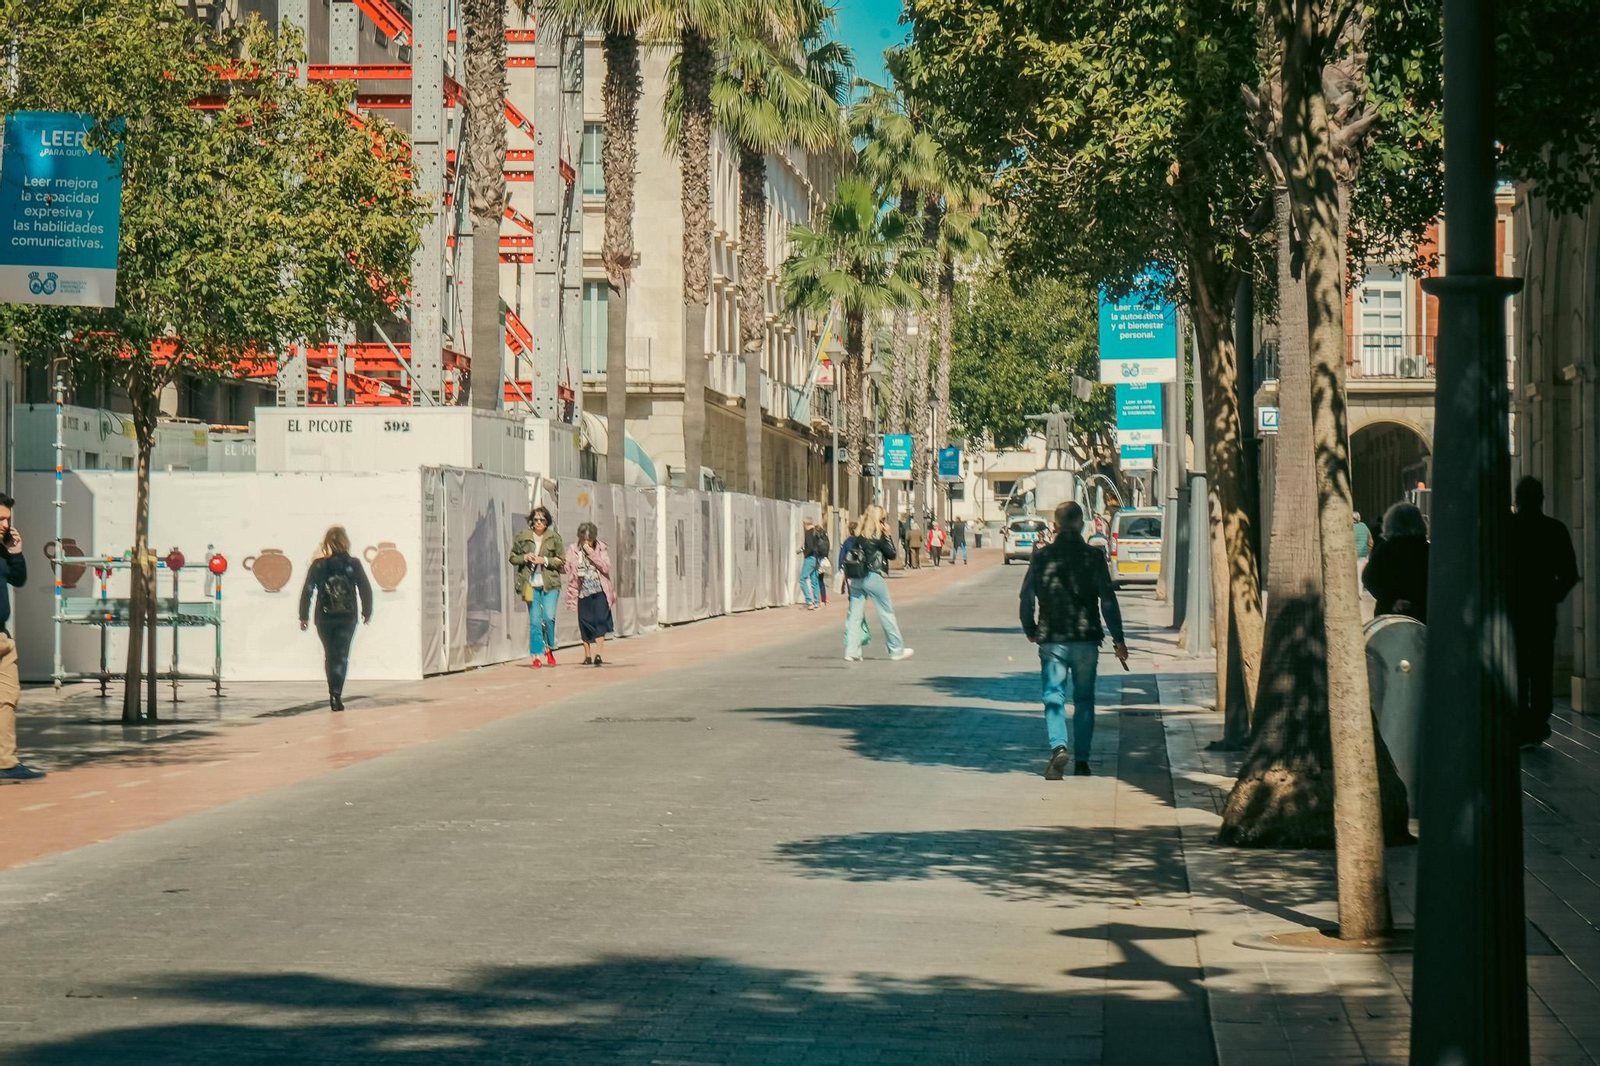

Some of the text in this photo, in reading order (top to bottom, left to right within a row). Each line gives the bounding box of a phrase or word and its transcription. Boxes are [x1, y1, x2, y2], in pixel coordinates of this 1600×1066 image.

[41, 129, 88, 147] LEER
[39, 148, 64, 157] ¿PARA
[24, 176, 98, 191] Leer mejora
[21, 190, 99, 204] la capacidad
[24, 206, 94, 221] expresiva y
[13, 219, 104, 234] las habilidades
[11, 235, 104, 249] comunicativas.
[1113, 303, 1131, 311] Leer
[1111, 311, 1164, 320] la autoestima
[1110, 321, 1164, 331] y el bienestar
[1119, 331, 1156, 341] personal.
[288, 419, 302, 432] EL
[308, 419, 353, 433] PICOTE
[224, 444, 238, 456] EL
